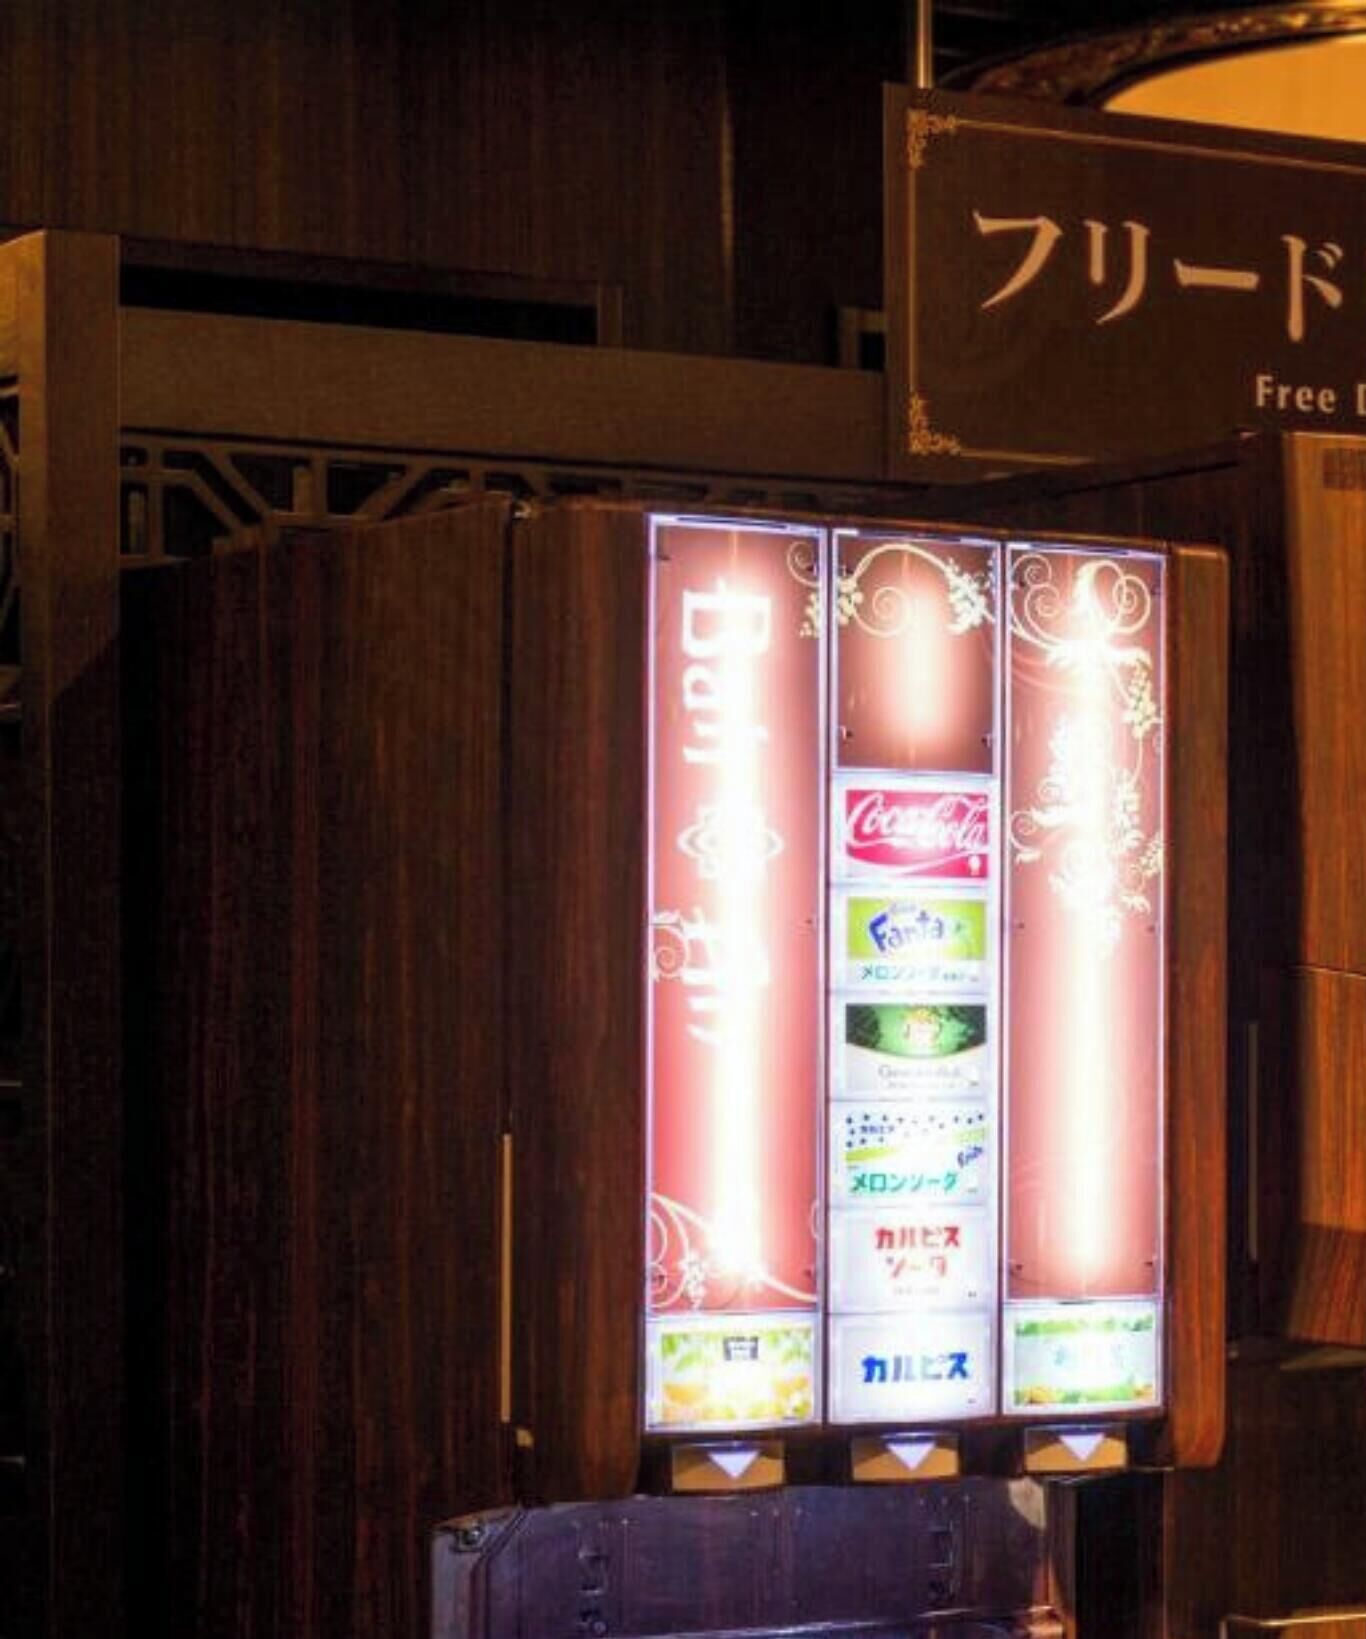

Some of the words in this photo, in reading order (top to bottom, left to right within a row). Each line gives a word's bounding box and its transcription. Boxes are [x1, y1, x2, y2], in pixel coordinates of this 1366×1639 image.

[1254, 374, 1337, 414] Free
[868, 912, 945, 952] Fanta
[876, 1226, 960, 1249] カルピス
[861, 1352, 969, 1384] カルピス
